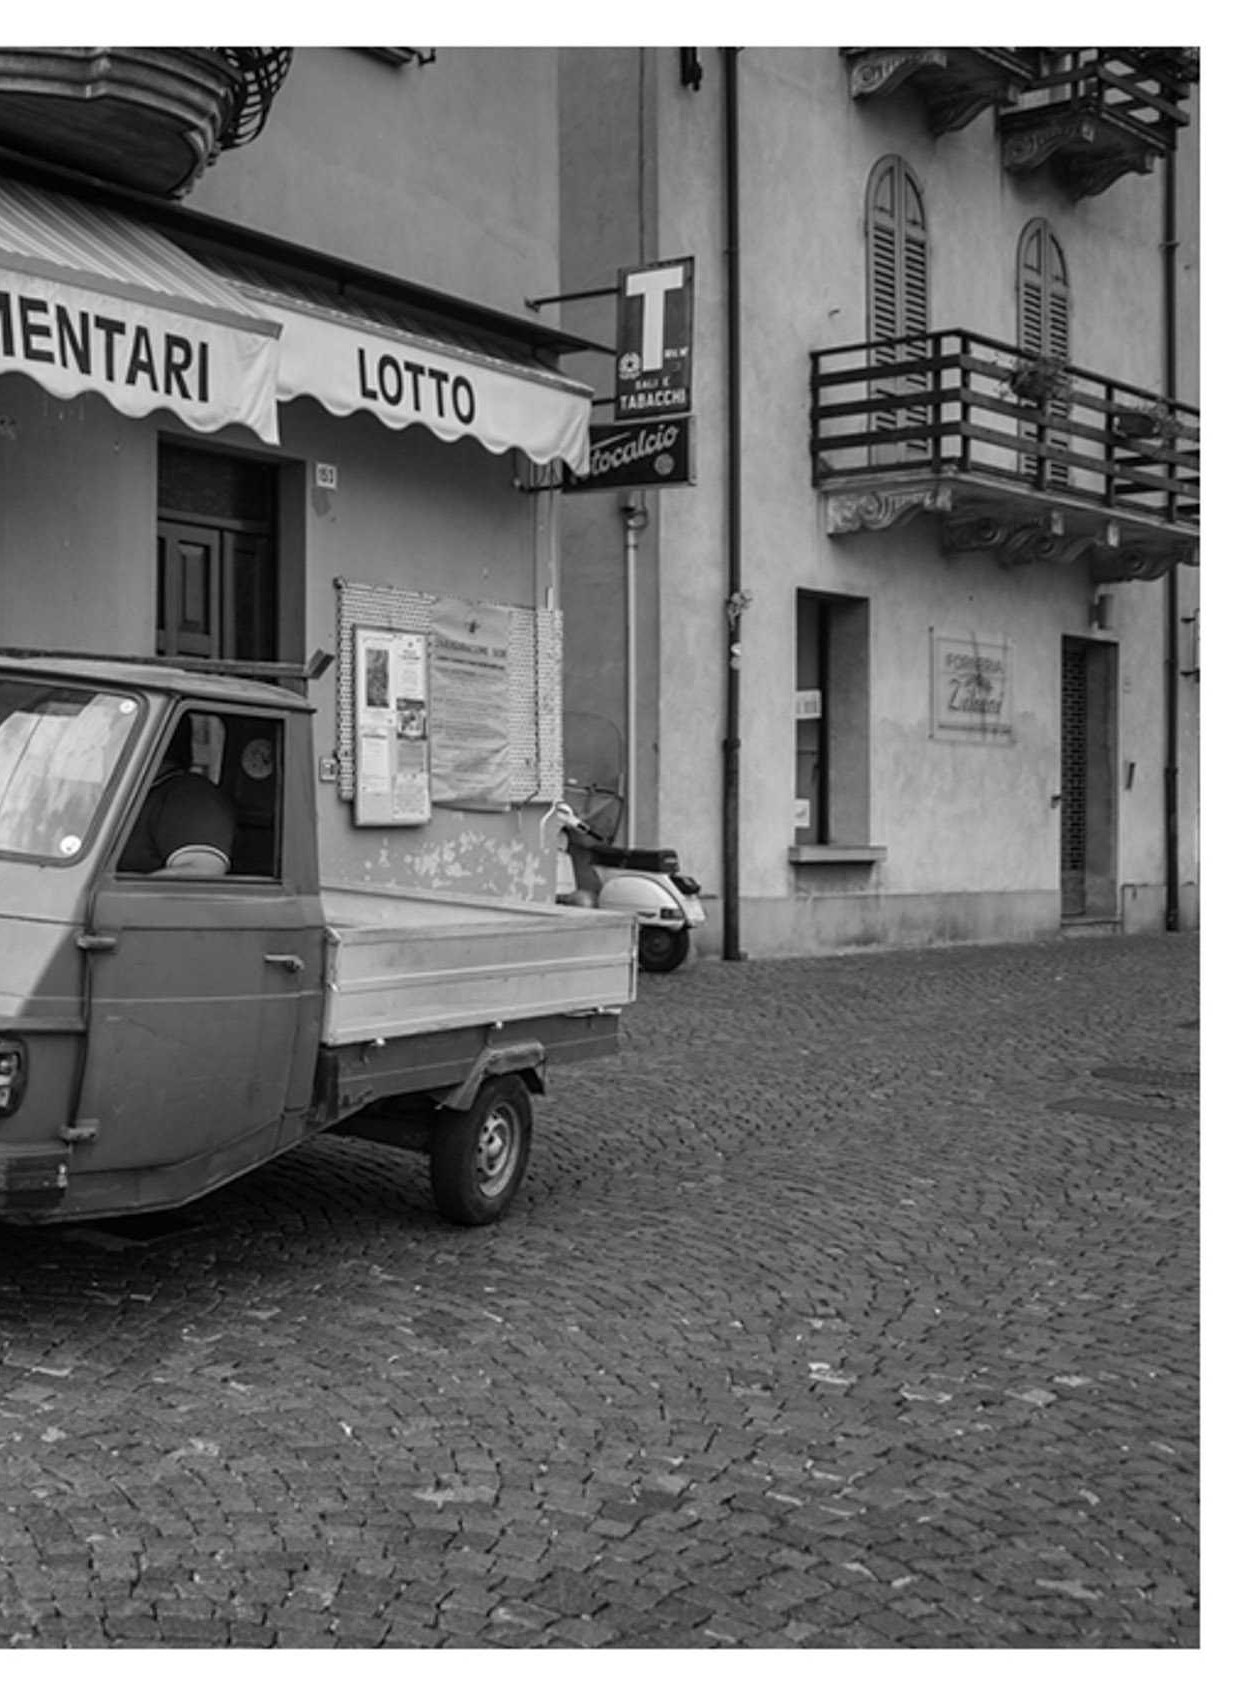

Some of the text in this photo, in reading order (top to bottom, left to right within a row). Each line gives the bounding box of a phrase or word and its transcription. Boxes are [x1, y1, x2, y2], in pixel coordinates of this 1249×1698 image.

[625, 265, 684, 372] T
[357, 347, 476, 425] LOTTO
[620, 388, 686, 410] TABACCHI
[590, 424, 680, 476] tocalcio
